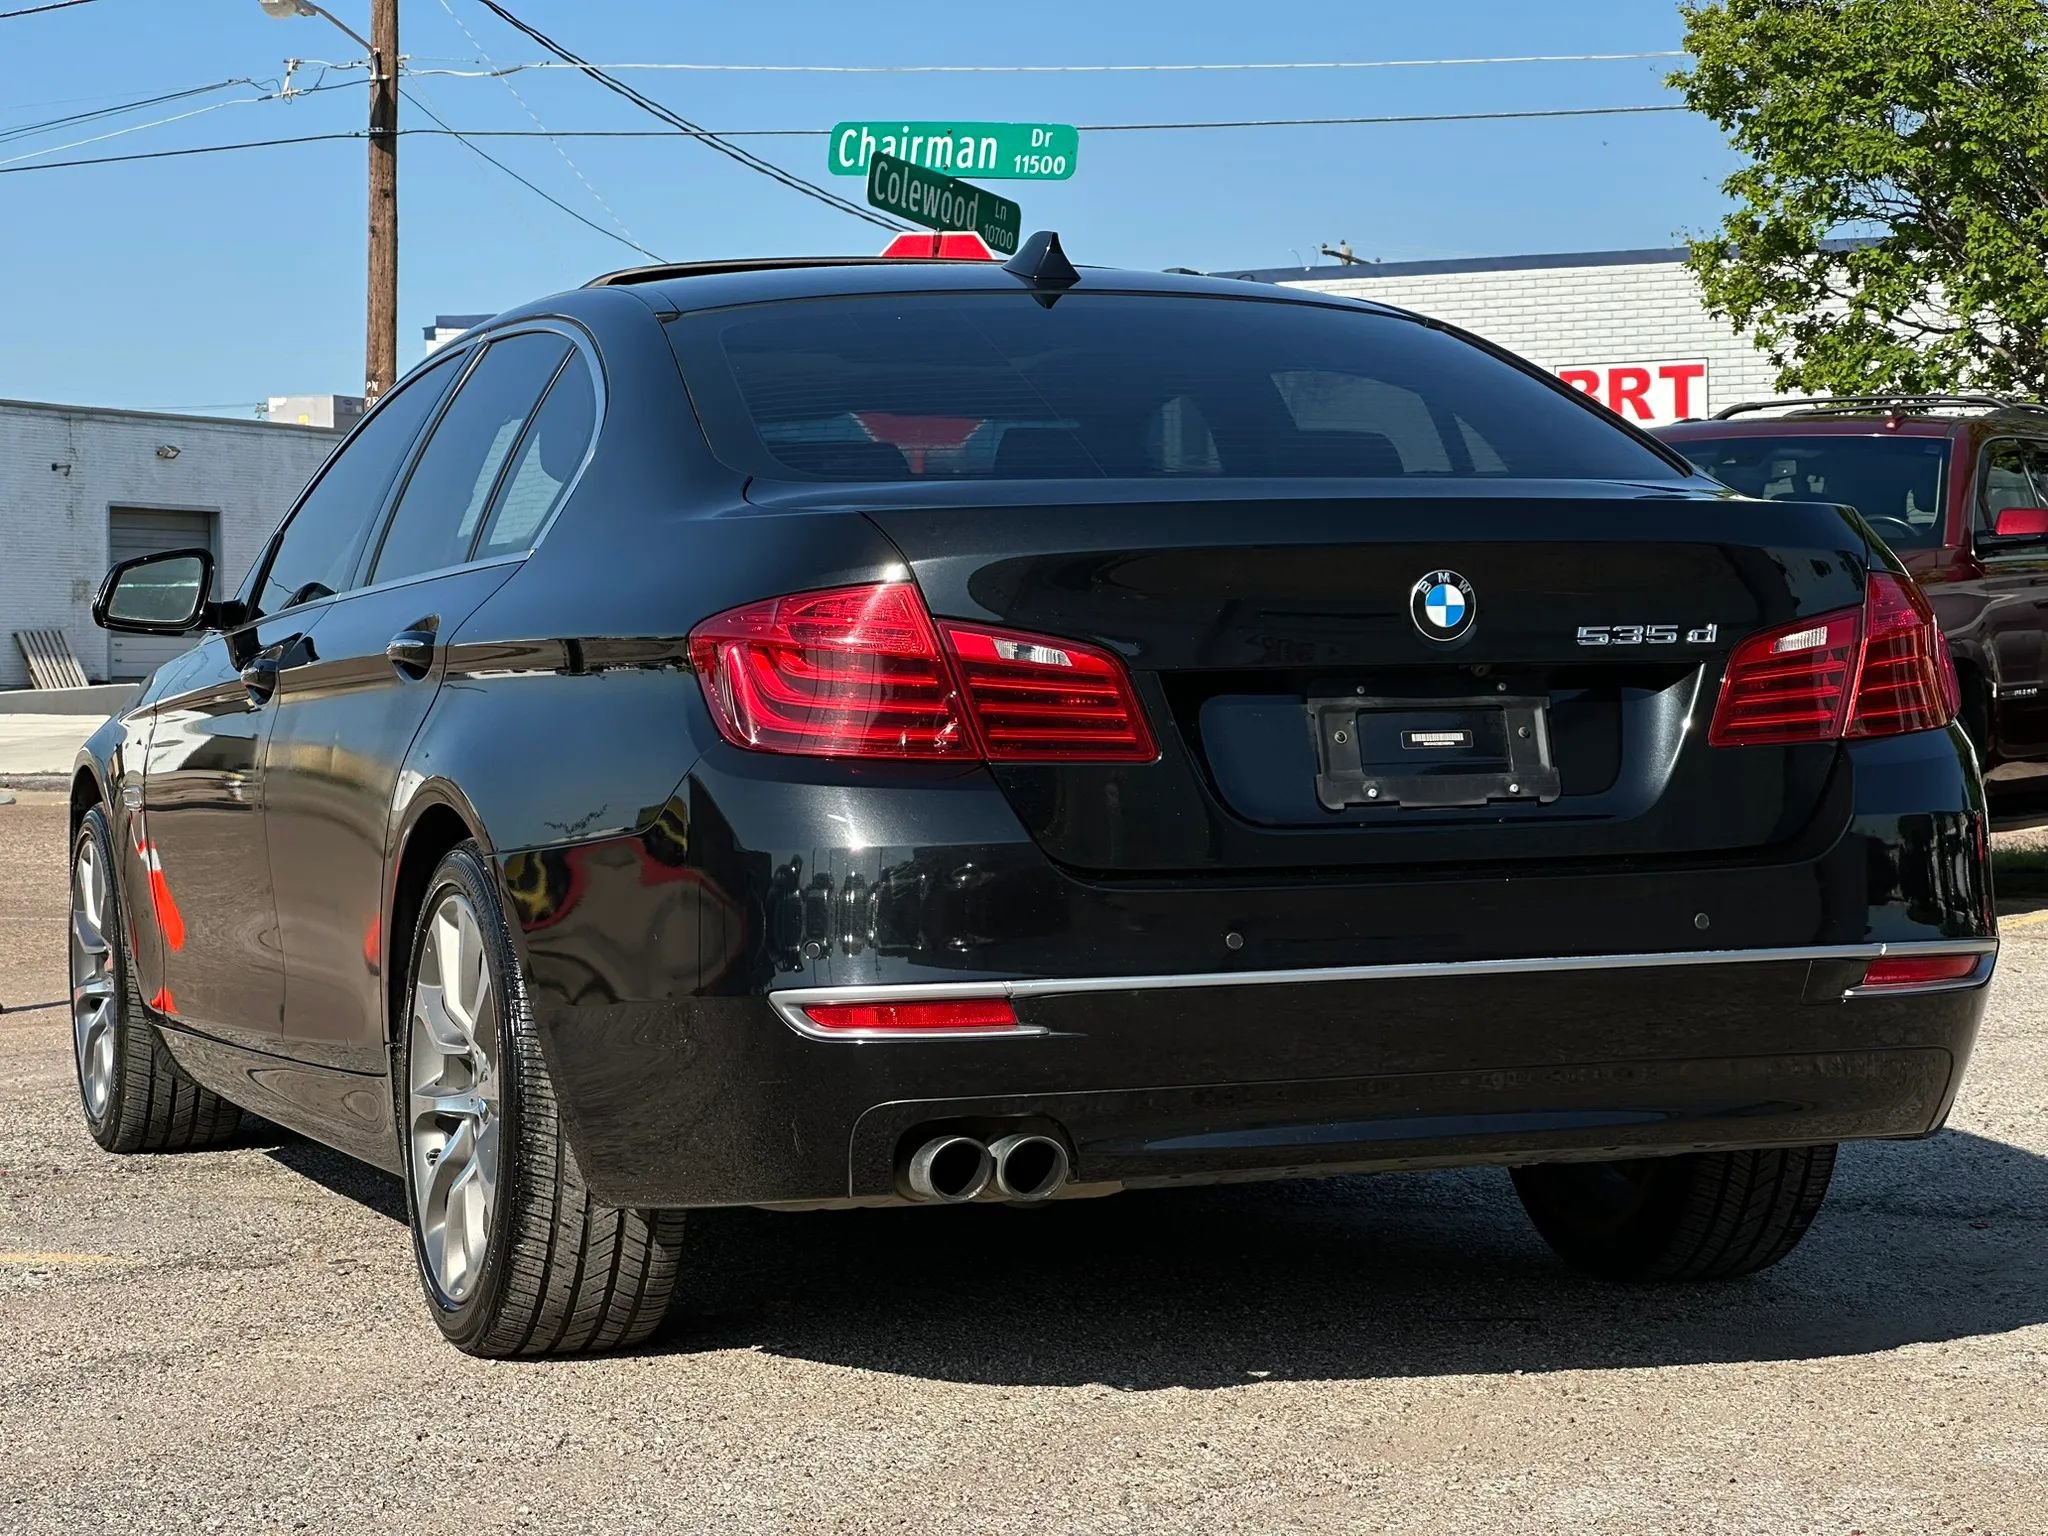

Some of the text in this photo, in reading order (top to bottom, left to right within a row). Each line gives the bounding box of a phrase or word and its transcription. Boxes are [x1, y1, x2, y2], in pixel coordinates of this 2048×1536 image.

[1031, 128, 1054, 148] Dr
[1013, 154, 1066, 175] 11500
[874, 160, 1007, 232] Colewood Ln
[984, 223, 1014, 249] 10700
[1417, 572, 1471, 595] BMW
